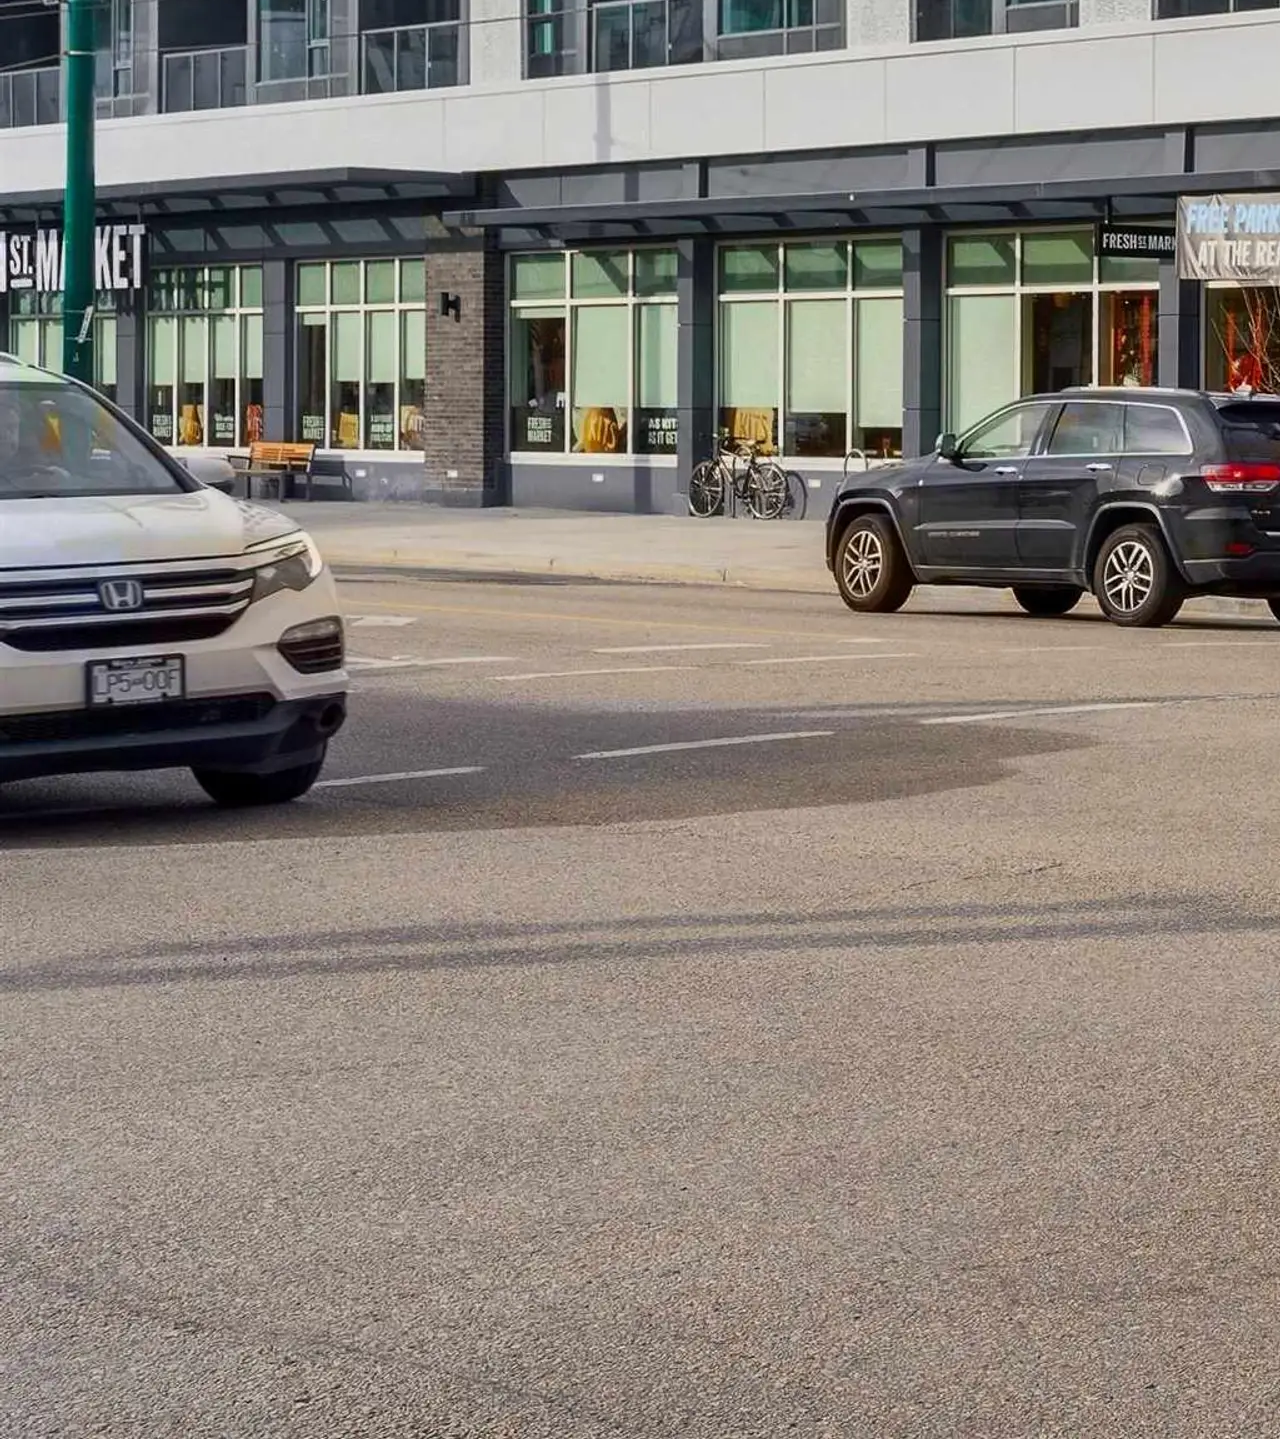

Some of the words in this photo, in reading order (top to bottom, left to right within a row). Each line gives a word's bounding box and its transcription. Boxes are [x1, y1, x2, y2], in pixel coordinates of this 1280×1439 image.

[1187, 202, 1229, 235] FREE
[1102, 232, 1138, 250] FRESH
[1199, 241, 1218, 268] AT
[1219, 240, 1251, 268] THE
[36, 224, 145, 292] MKET
[588, 417, 618, 450] KITS
